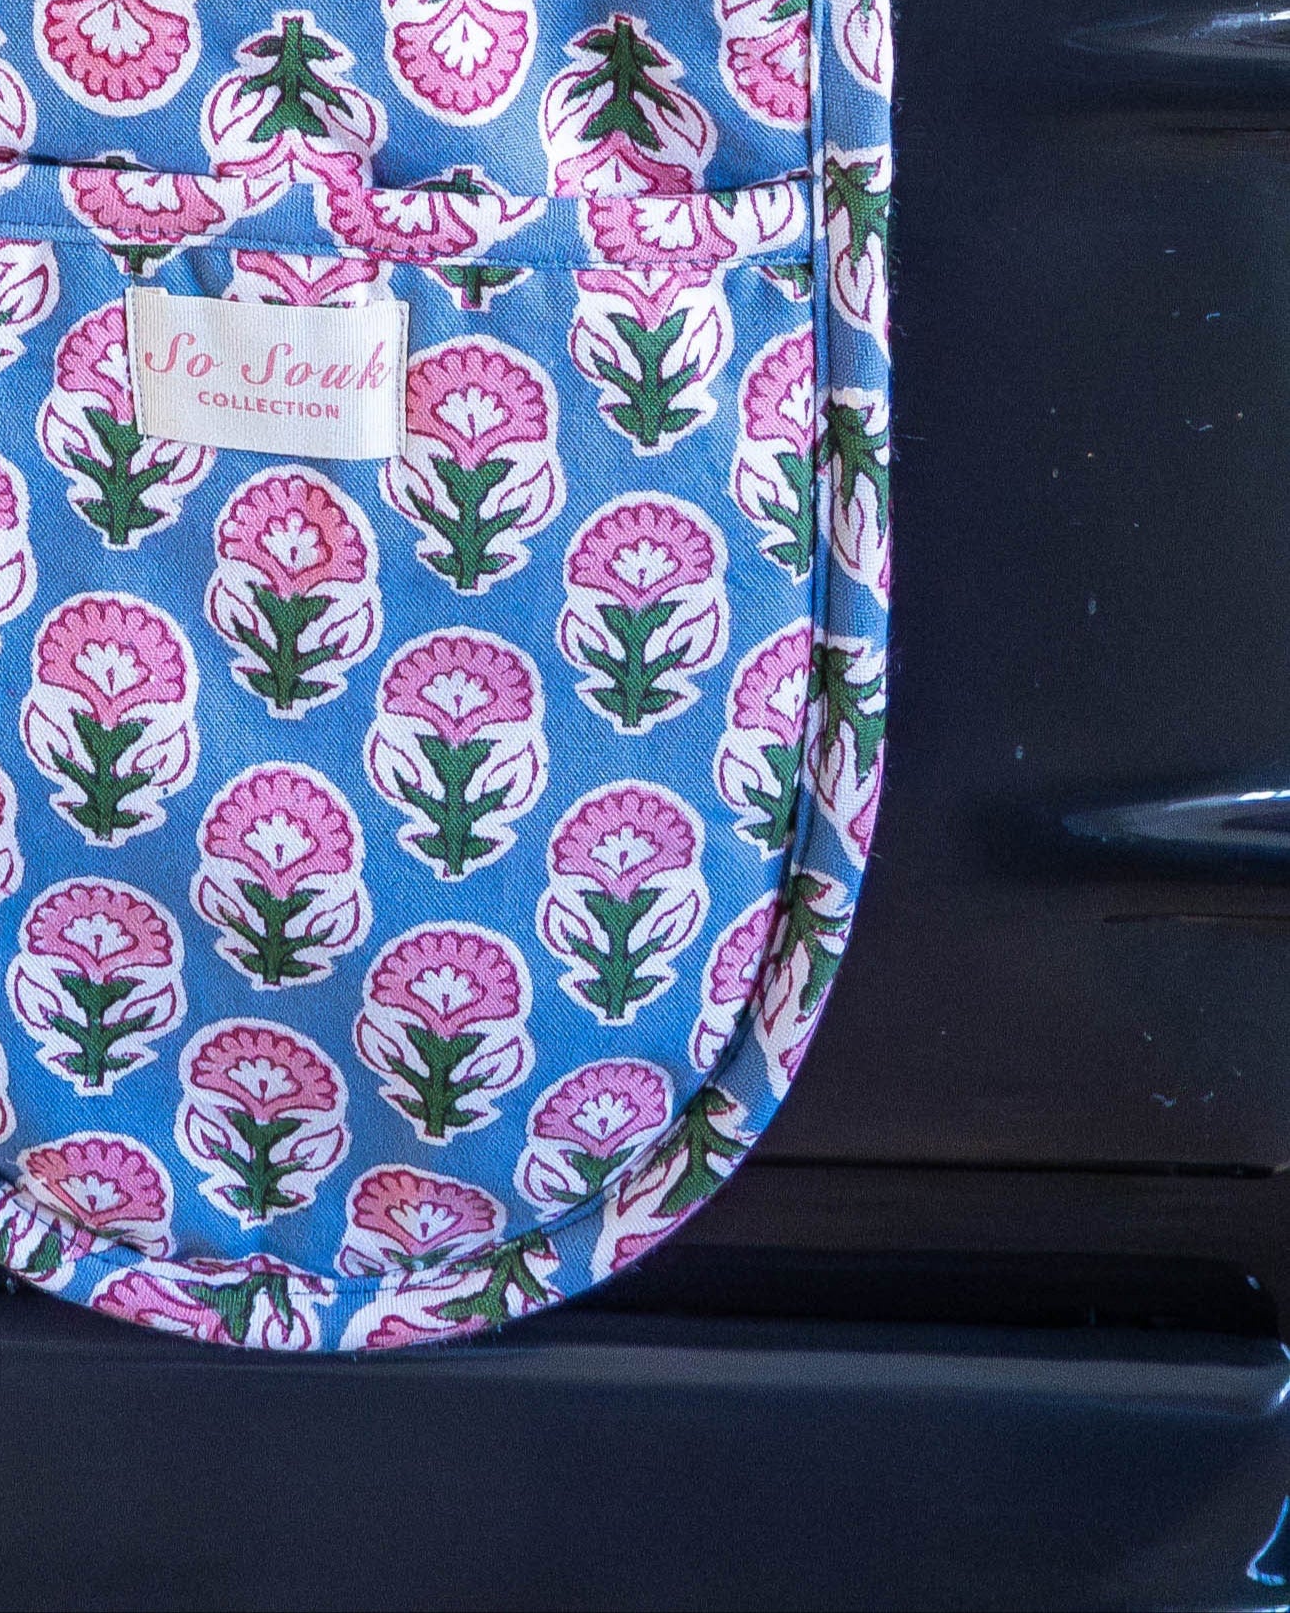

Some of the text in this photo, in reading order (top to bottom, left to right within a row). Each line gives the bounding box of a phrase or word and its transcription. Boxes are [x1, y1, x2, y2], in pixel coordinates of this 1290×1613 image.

[145, 332, 391, 391] So Souk
[198, 391, 340, 420] COLLECTION
